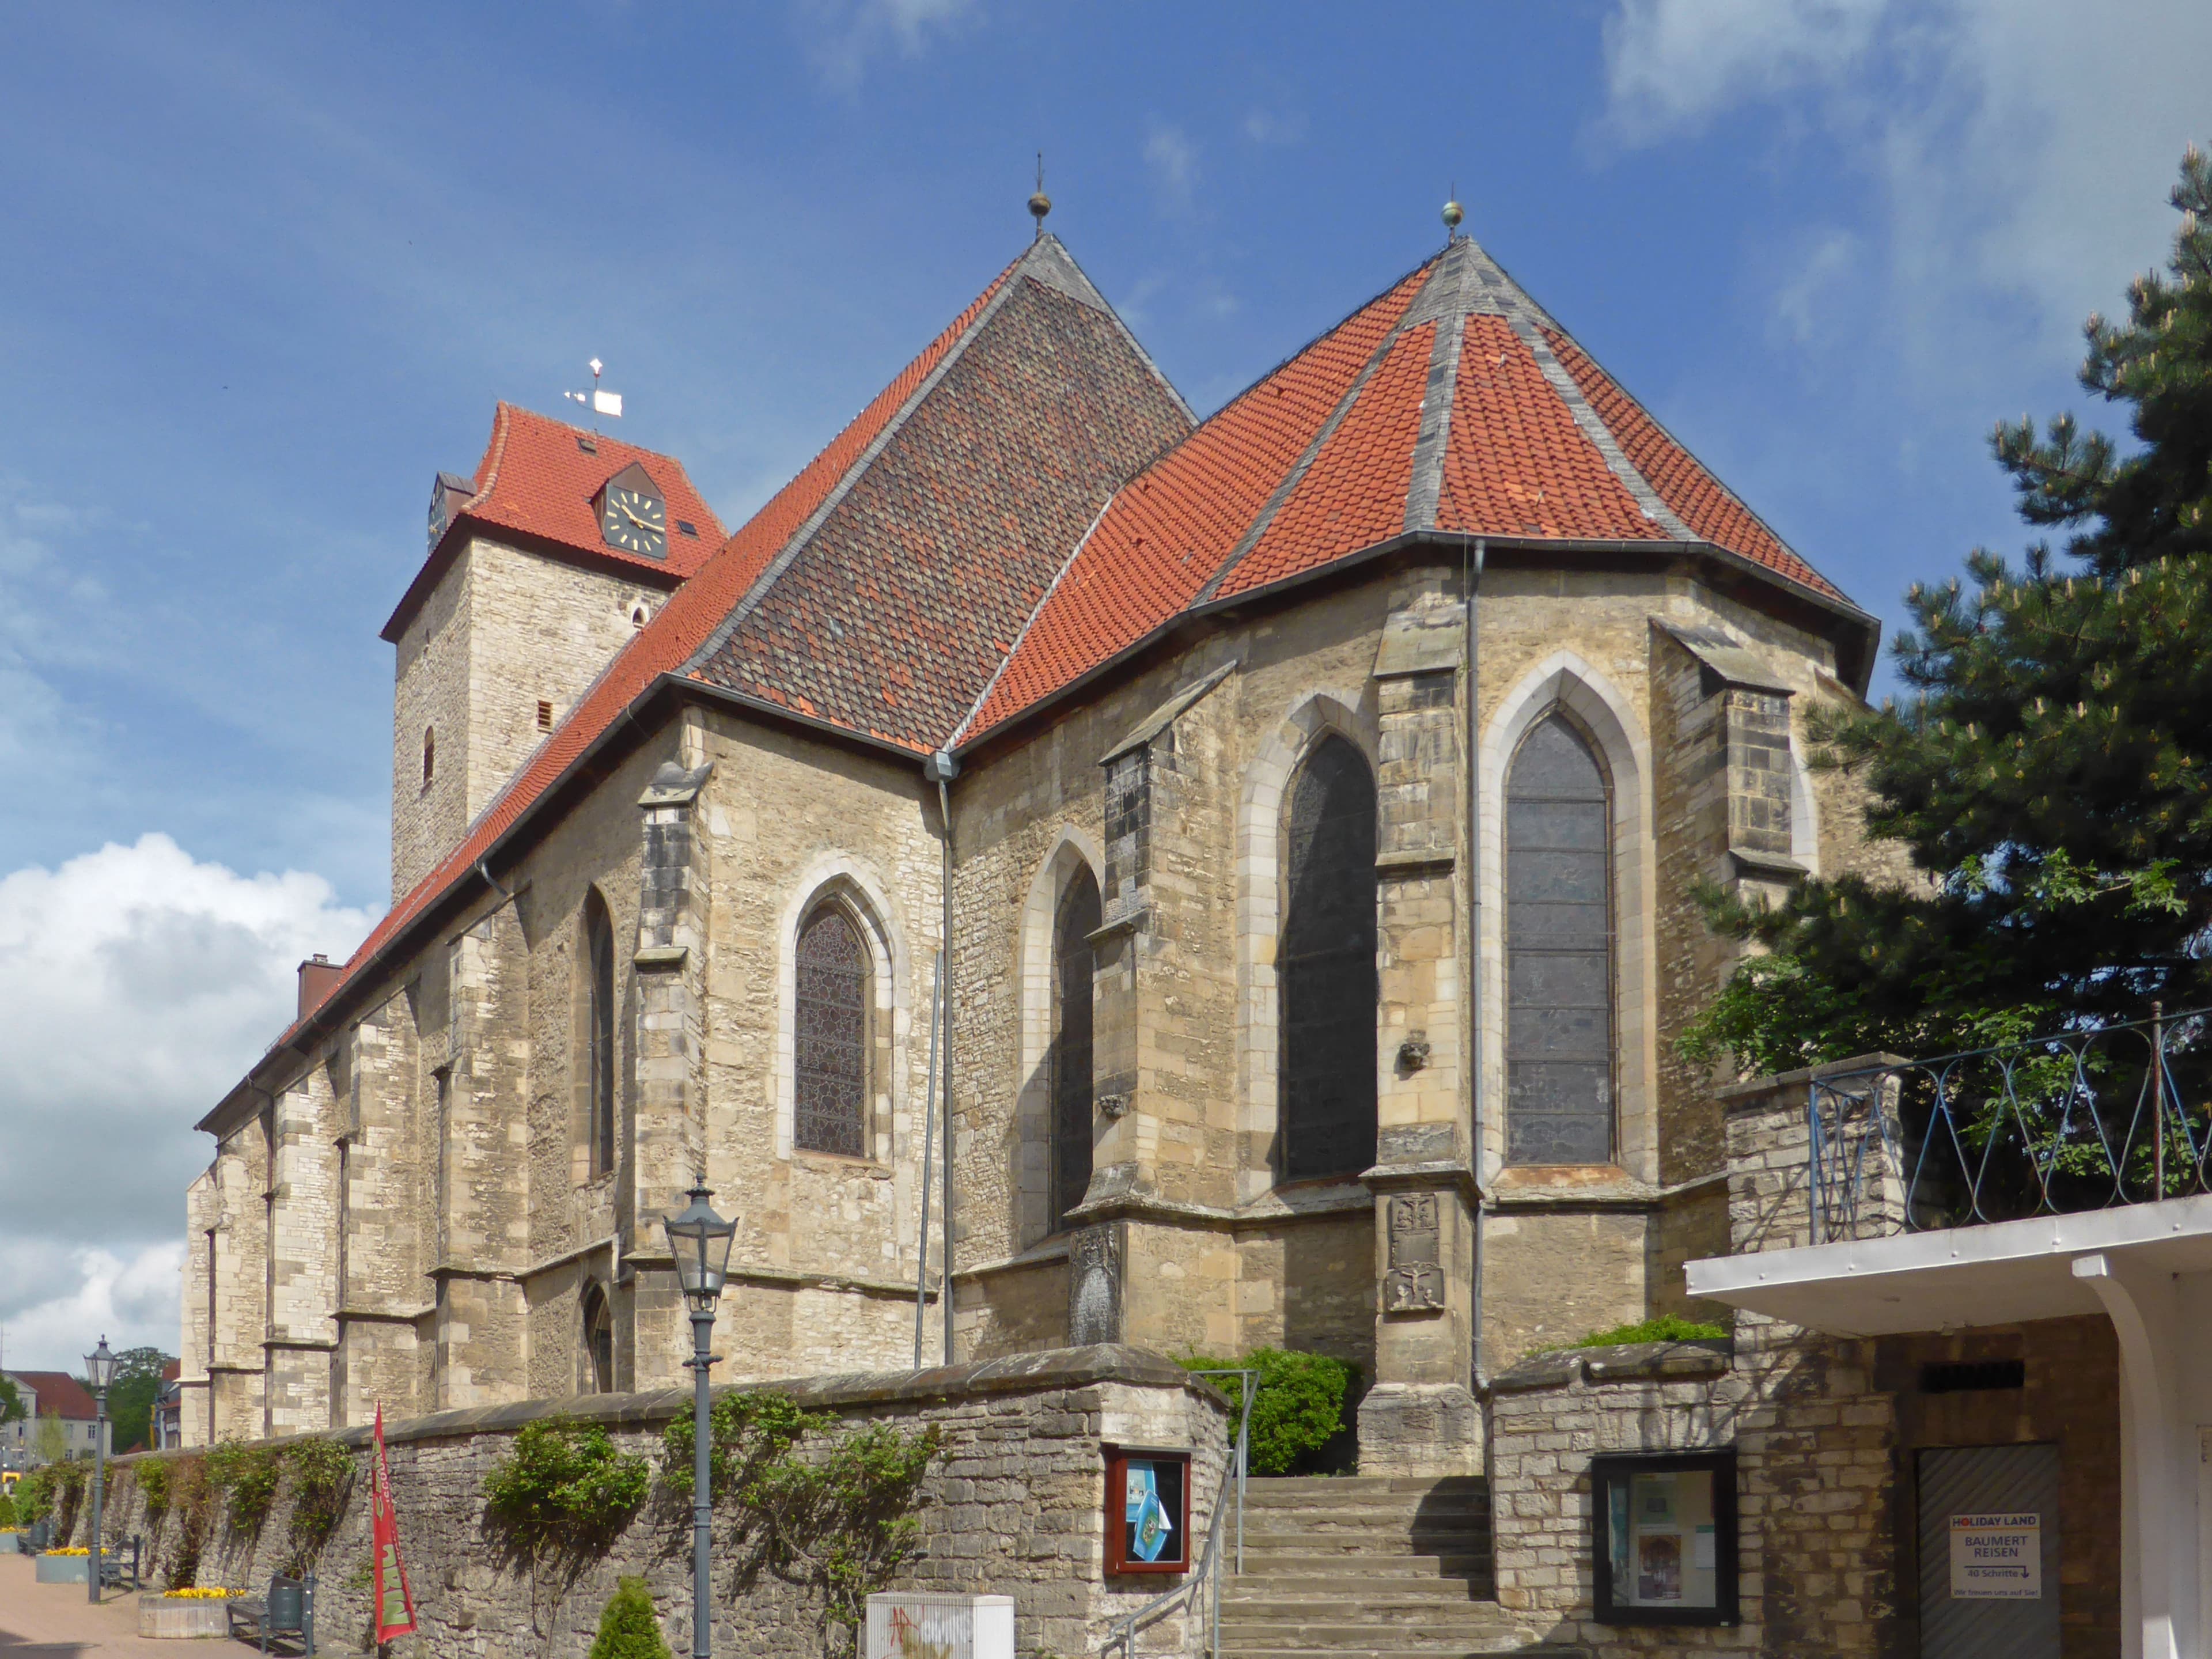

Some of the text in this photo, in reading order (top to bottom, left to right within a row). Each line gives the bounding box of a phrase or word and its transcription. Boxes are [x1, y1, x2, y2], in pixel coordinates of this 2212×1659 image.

[1953, 1516, 2037, 1527] HOLIDAY LAND
[1965, 1536, 2028, 1547] BAUMERT
[1974, 1548, 2018, 1558] REISEN
[1982, 1569, 2019, 1577] Schritte
